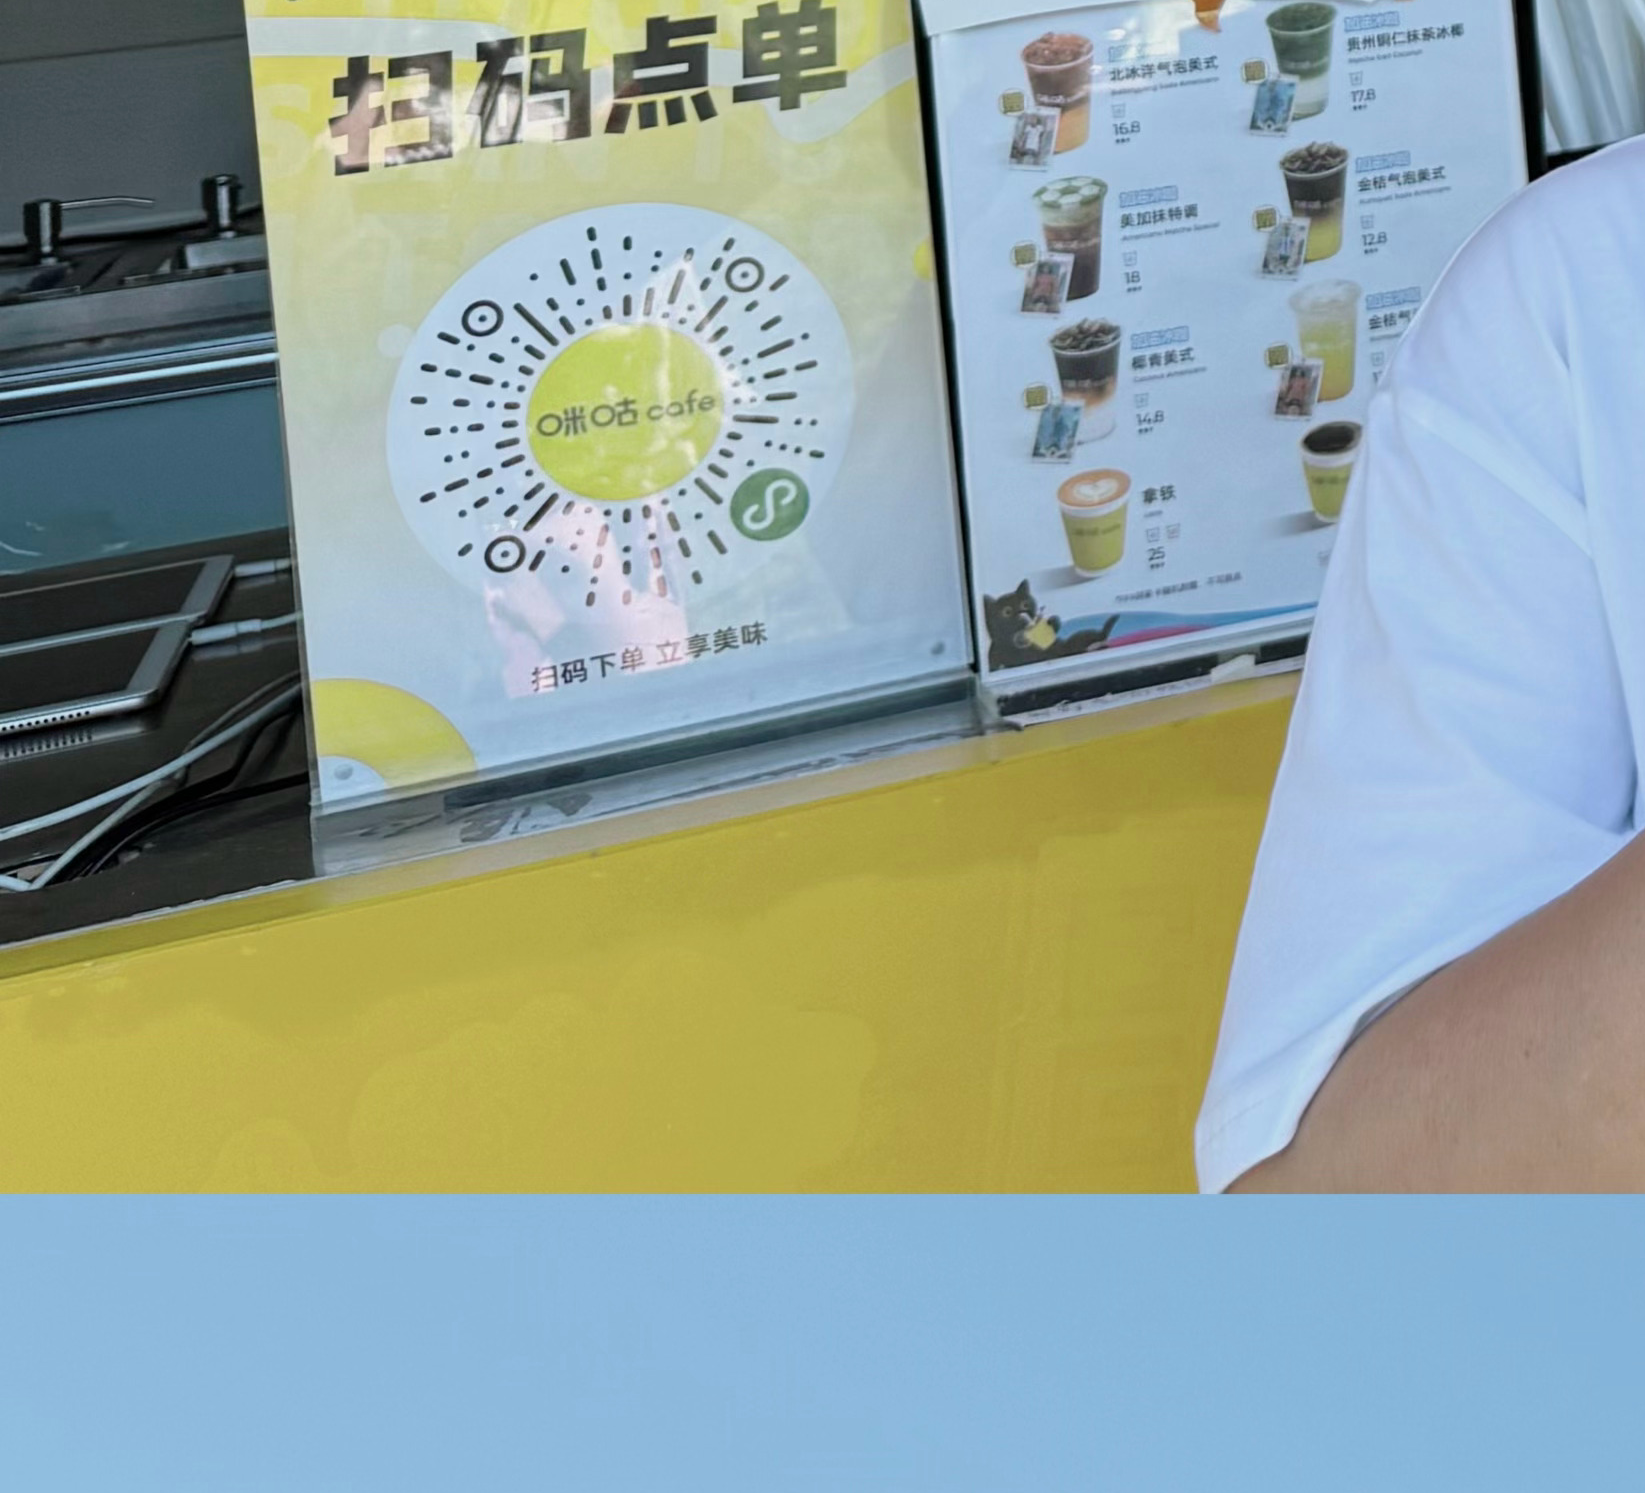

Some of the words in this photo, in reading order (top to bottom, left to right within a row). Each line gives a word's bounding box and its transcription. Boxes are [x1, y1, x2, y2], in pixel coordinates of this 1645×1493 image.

[1109, 56, 1219, 82] 北冰洋气泡美式
[1351, 88, 1376, 103] 17.8
[1112, 120, 1141, 136] 16.8
[1358, 166, 1446, 192] 金桔气泡美式
[1361, 232, 1388, 247] 12.8
[537, 398, 639, 437] 咪咕
[647, 389, 716, 422] cafe
[1148, 547, 1166, 561] 25
[532, 648, 646, 692] 扫码下单
[656, 621, 769, 666] 立享美味
